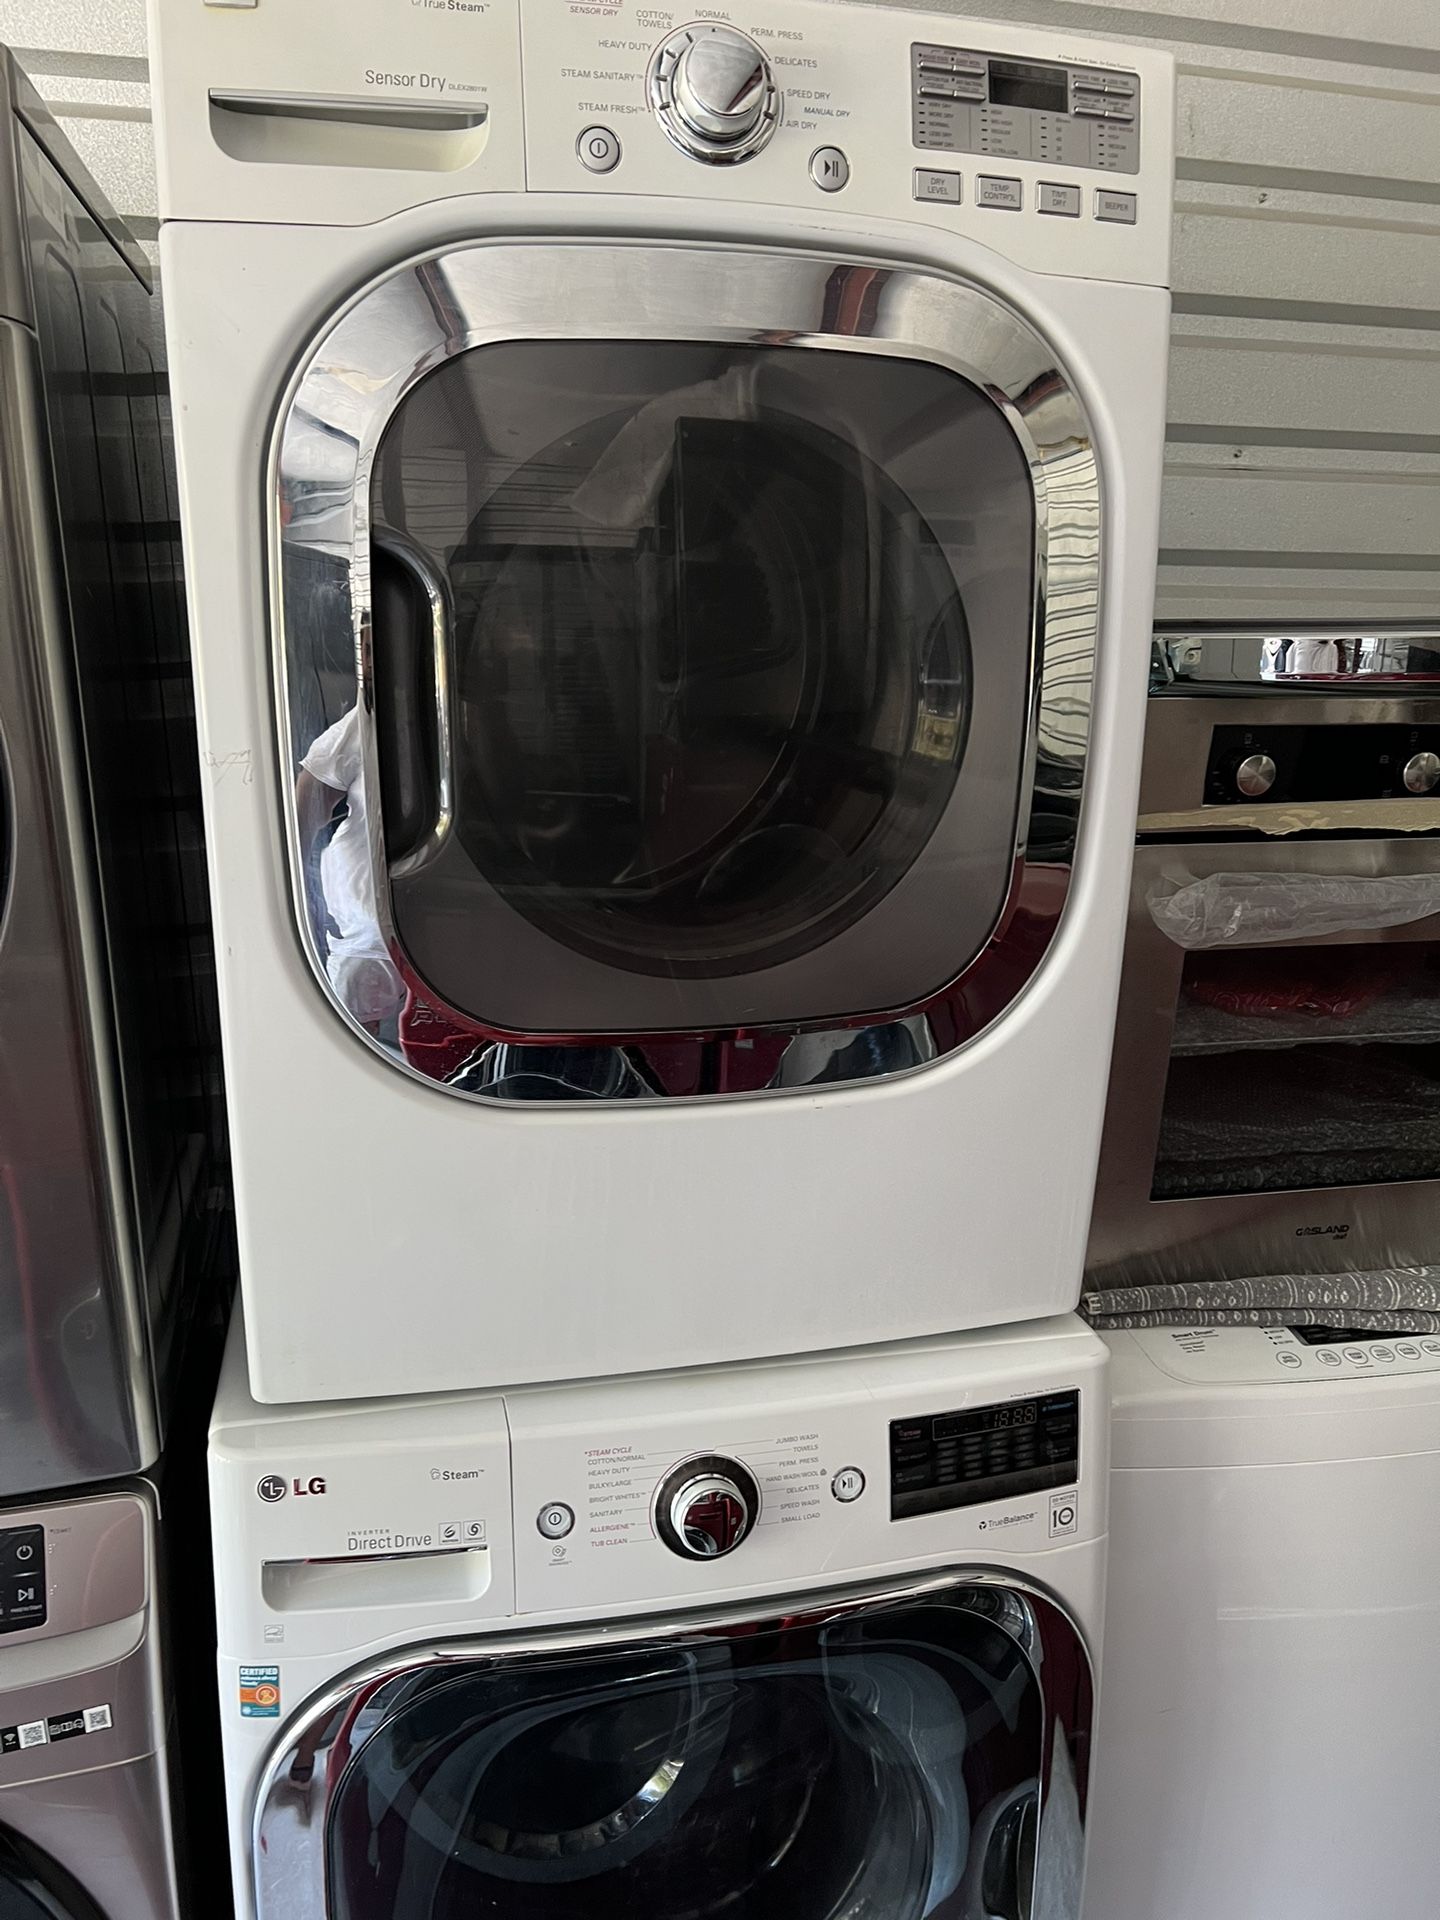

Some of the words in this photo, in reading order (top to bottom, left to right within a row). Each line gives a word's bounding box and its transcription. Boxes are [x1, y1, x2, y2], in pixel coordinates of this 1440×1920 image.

[570, 5, 601, 15] SENSOR
[602, 8, 619, 16] DRY
[636, 9, 674, 20] COTTON/
[695, 9, 731, 21] NORMAL
[637, 19, 673, 30] TOWELS
[751, 28, 775, 38] PERM.
[778, 30, 803, 41] PRESS
[598, 40, 626, 51] HEAVY
[628, 42, 652, 52] DUTY
[774, 57, 818, 69] DELICATES
[560, 68, 591, 80] STEAM
[365, 70, 416, 87] Sensor
[420, 73, 446, 92] Dry
[787, 89, 809, 99] SPEED
[811, 91, 831, 101] DRY
[578, 102, 606, 113] STEAM
[804, 106, 834, 117] MANUAL
[835, 109, 850, 118] DRY
[786, 120, 799, 129] AIR
[800, 121, 818, 131] DRY
[931, 177, 946, 187] DRY
[927, 185, 948, 196] LEVEL
[983, 191, 1017, 203] CONTROL
[1052, 198, 1067, 207] DRY
[1104, 201, 1129, 212] BEEPER
[775, 1435, 798, 1445] JUMBO
[799, 1433, 820, 1442] WASH
[611, 1446, 633, 1455] CYCLE
[793, 1443, 819, 1453] TOWELS
[587, 1454, 646, 1466] COTTON/NORMAL
[778, 1459, 797, 1468] PERM.
[798, 1457, 819, 1466] PRESS
[588, 1468, 611, 1477] HEAVY
[613, 1466, 631, 1475] DUTY
[293, 1476, 327, 1497] LG
[588, 1479, 633, 1491] BULKY/LARGE
[786, 1484, 820, 1495] DELICATES
[589, 1495, 613, 1504] BRIGHT
[780, 1501, 800, 1511] SPEED
[800, 1499, 821, 1508] WASH
[589, 1509, 623, 1519] SANITARY
[781, 1515, 802, 1524] SMALL
[803, 1512, 821, 1521] LOAD
[347, 1528, 391, 1536] INVERTER
[348, 1535, 392, 1551] Direct
[394, 1534, 432, 1547] Drive
[591, 1539, 605, 1548] TUB
[605, 1537, 628, 1547] CLEAN
[240, 1667, 278, 1676] CERTIFIED
